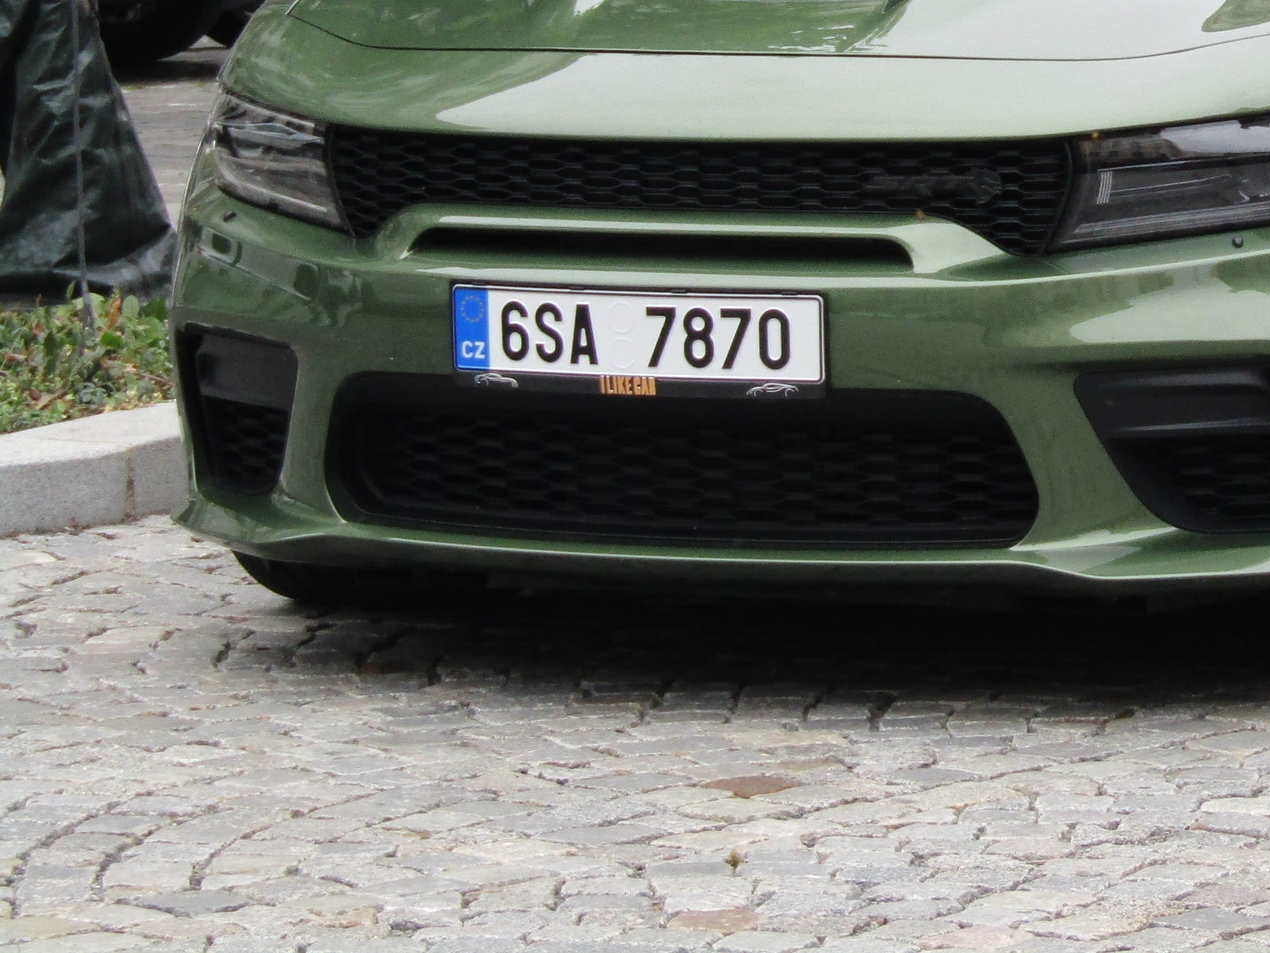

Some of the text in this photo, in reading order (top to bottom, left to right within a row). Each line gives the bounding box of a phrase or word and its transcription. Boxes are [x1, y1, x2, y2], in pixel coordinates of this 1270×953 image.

[462, 340, 485, 359] CZ
[501, 300, 791, 370] 6SA 7870
